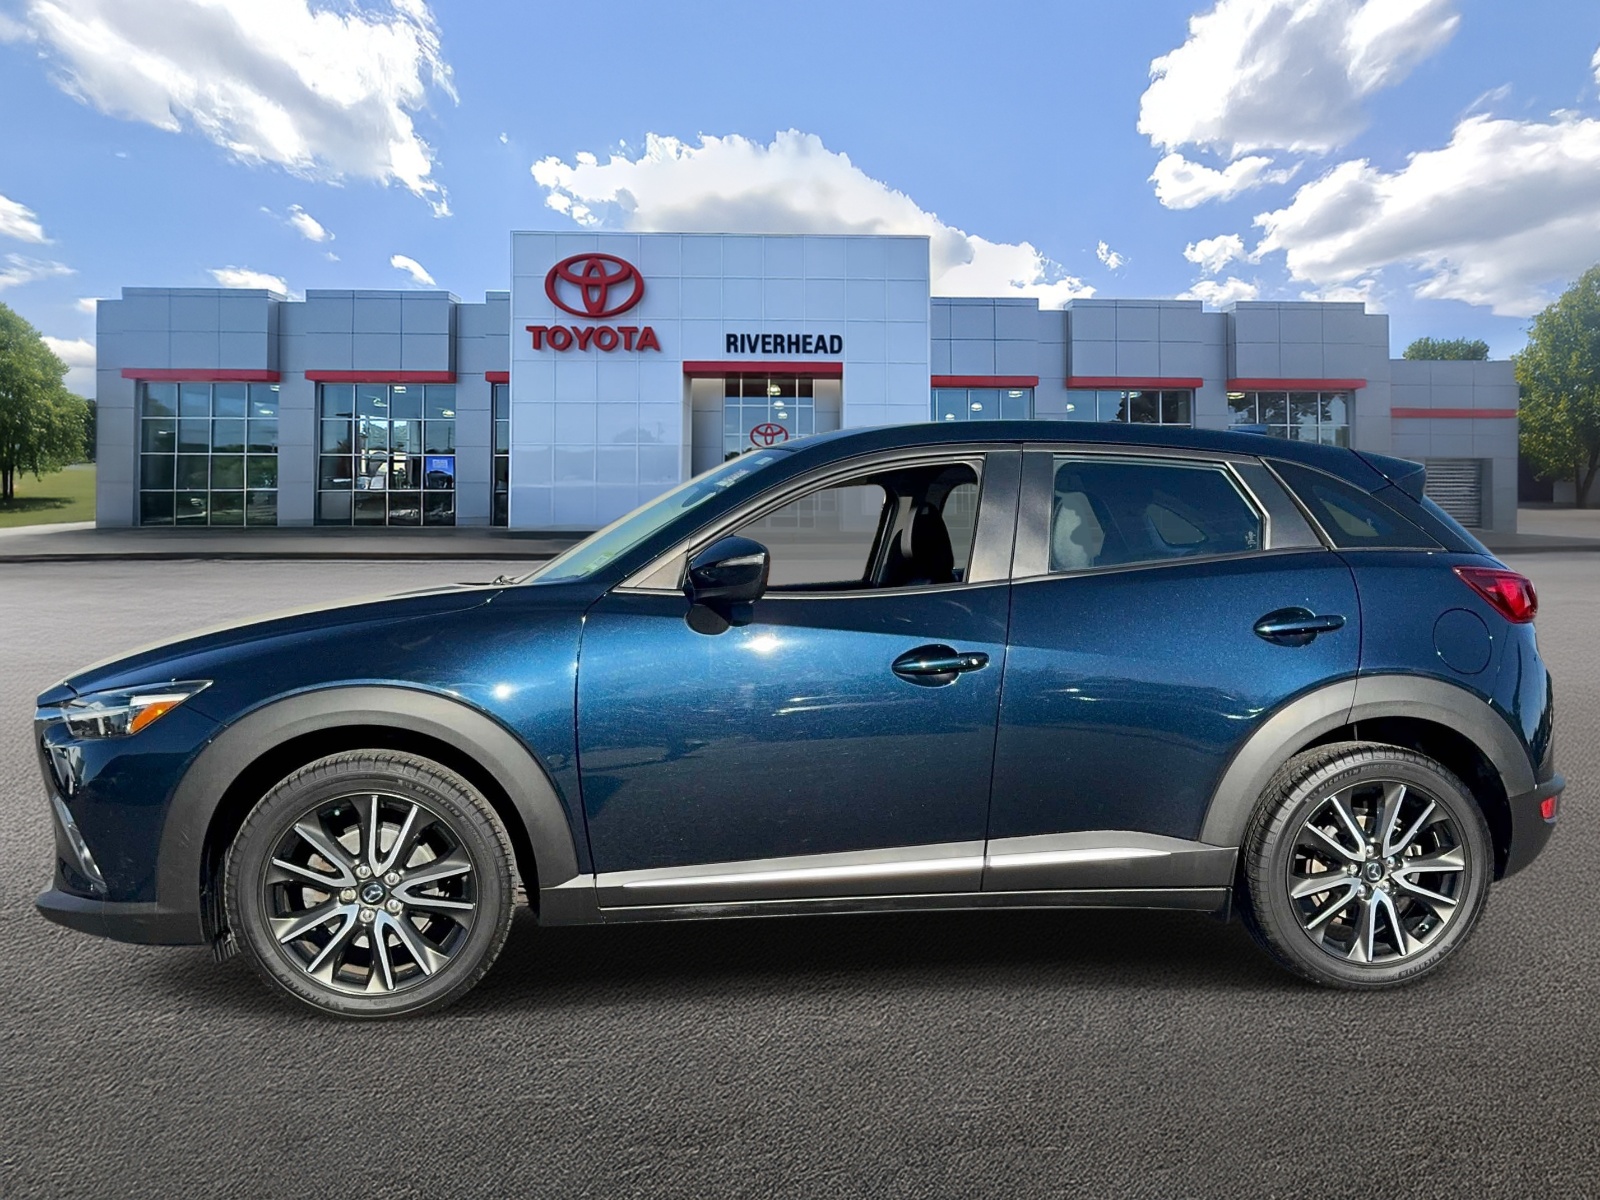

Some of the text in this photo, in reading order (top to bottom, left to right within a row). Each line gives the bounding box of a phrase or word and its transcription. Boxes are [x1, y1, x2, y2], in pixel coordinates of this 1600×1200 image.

[525, 325, 661, 352] TOYOTA
[726, 333, 843, 355] RIVERHEAD
[1318, 767, 1360, 793] MICHELIN
[415, 785, 461, 818] MICHELIN
